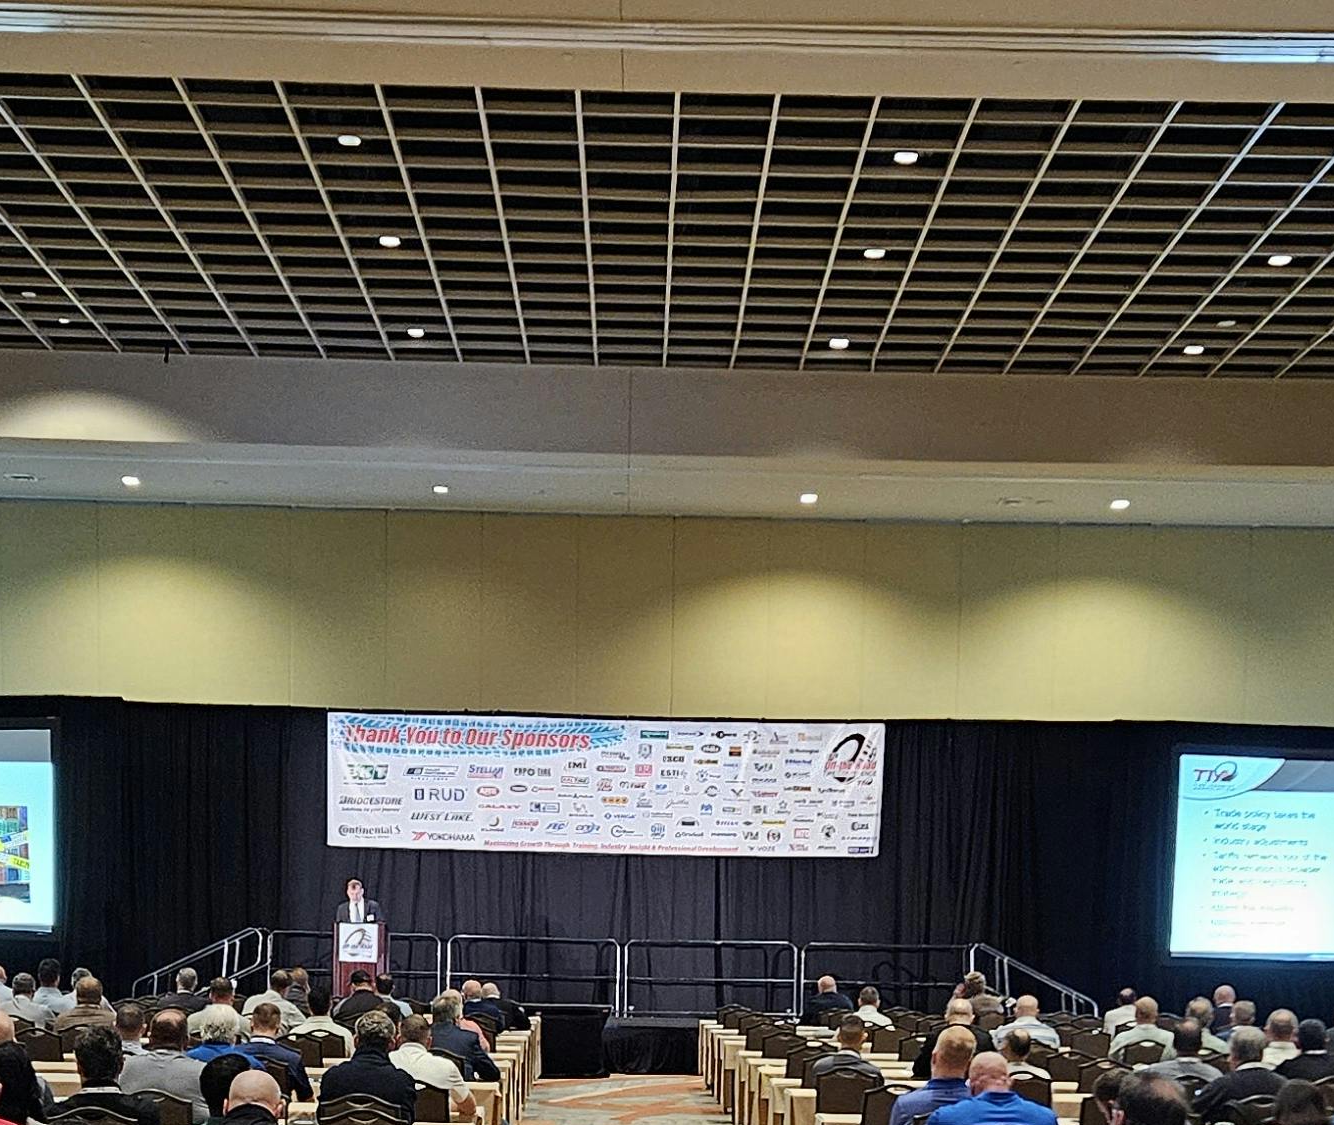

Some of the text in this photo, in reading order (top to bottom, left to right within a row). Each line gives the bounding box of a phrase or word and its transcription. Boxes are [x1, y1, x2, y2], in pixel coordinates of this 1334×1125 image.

[346, 724, 590, 751] Thank You to Our Sponsors
[339, 795, 404, 806] BRIDGESTONE
[429, 788, 465, 802] RUD
[338, 824, 393, 836] Continental
[427, 832, 475, 841] YOKOHAMA
